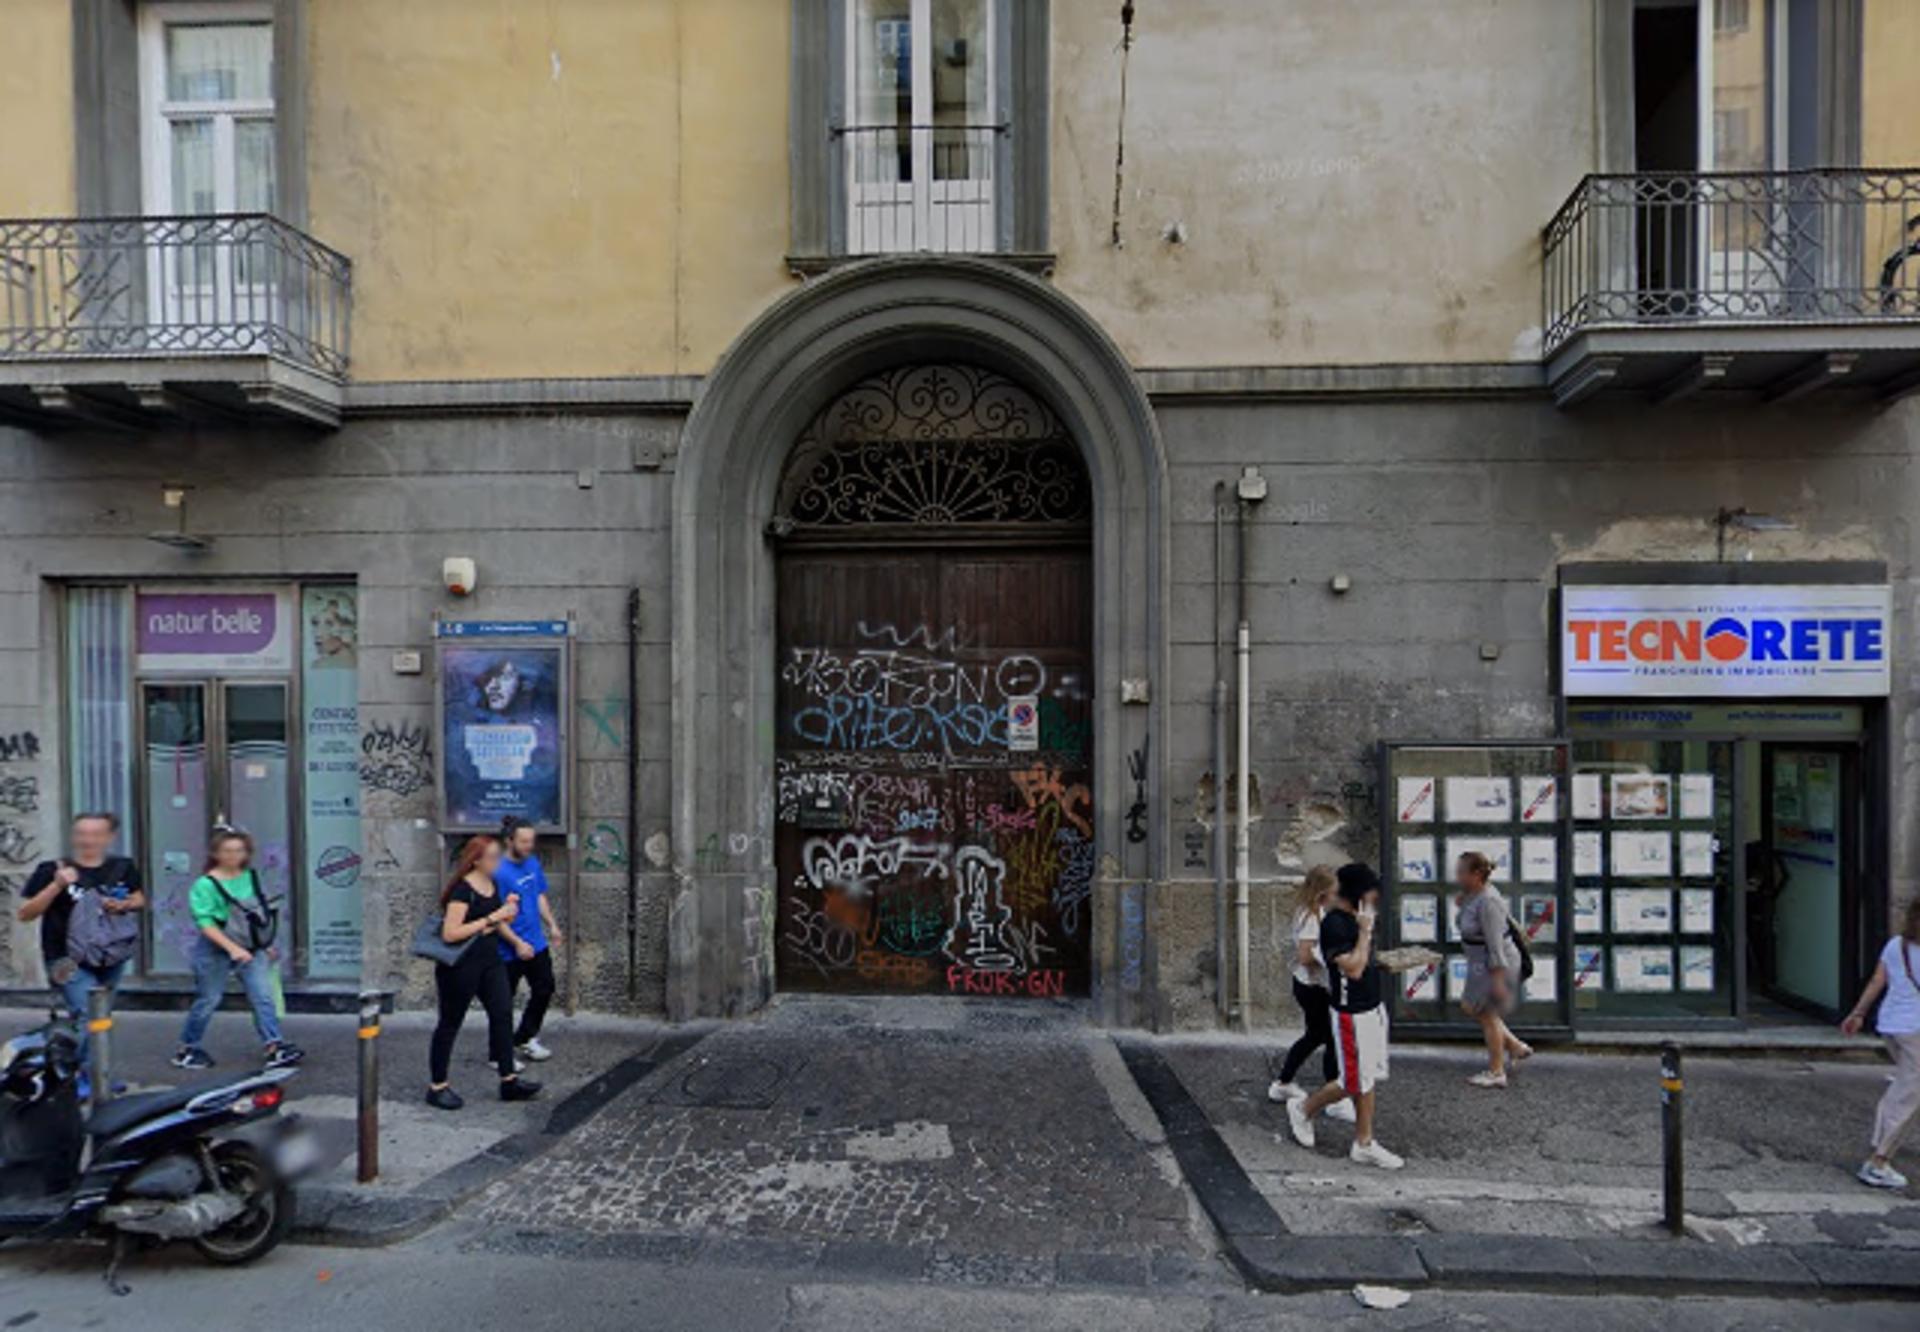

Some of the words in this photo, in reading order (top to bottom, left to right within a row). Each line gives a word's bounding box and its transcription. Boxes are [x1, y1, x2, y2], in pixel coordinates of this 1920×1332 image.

[149, 610, 207, 634] natur
[211, 607, 262, 634] belle
[1567, 616, 1883, 662] TECNORETE
